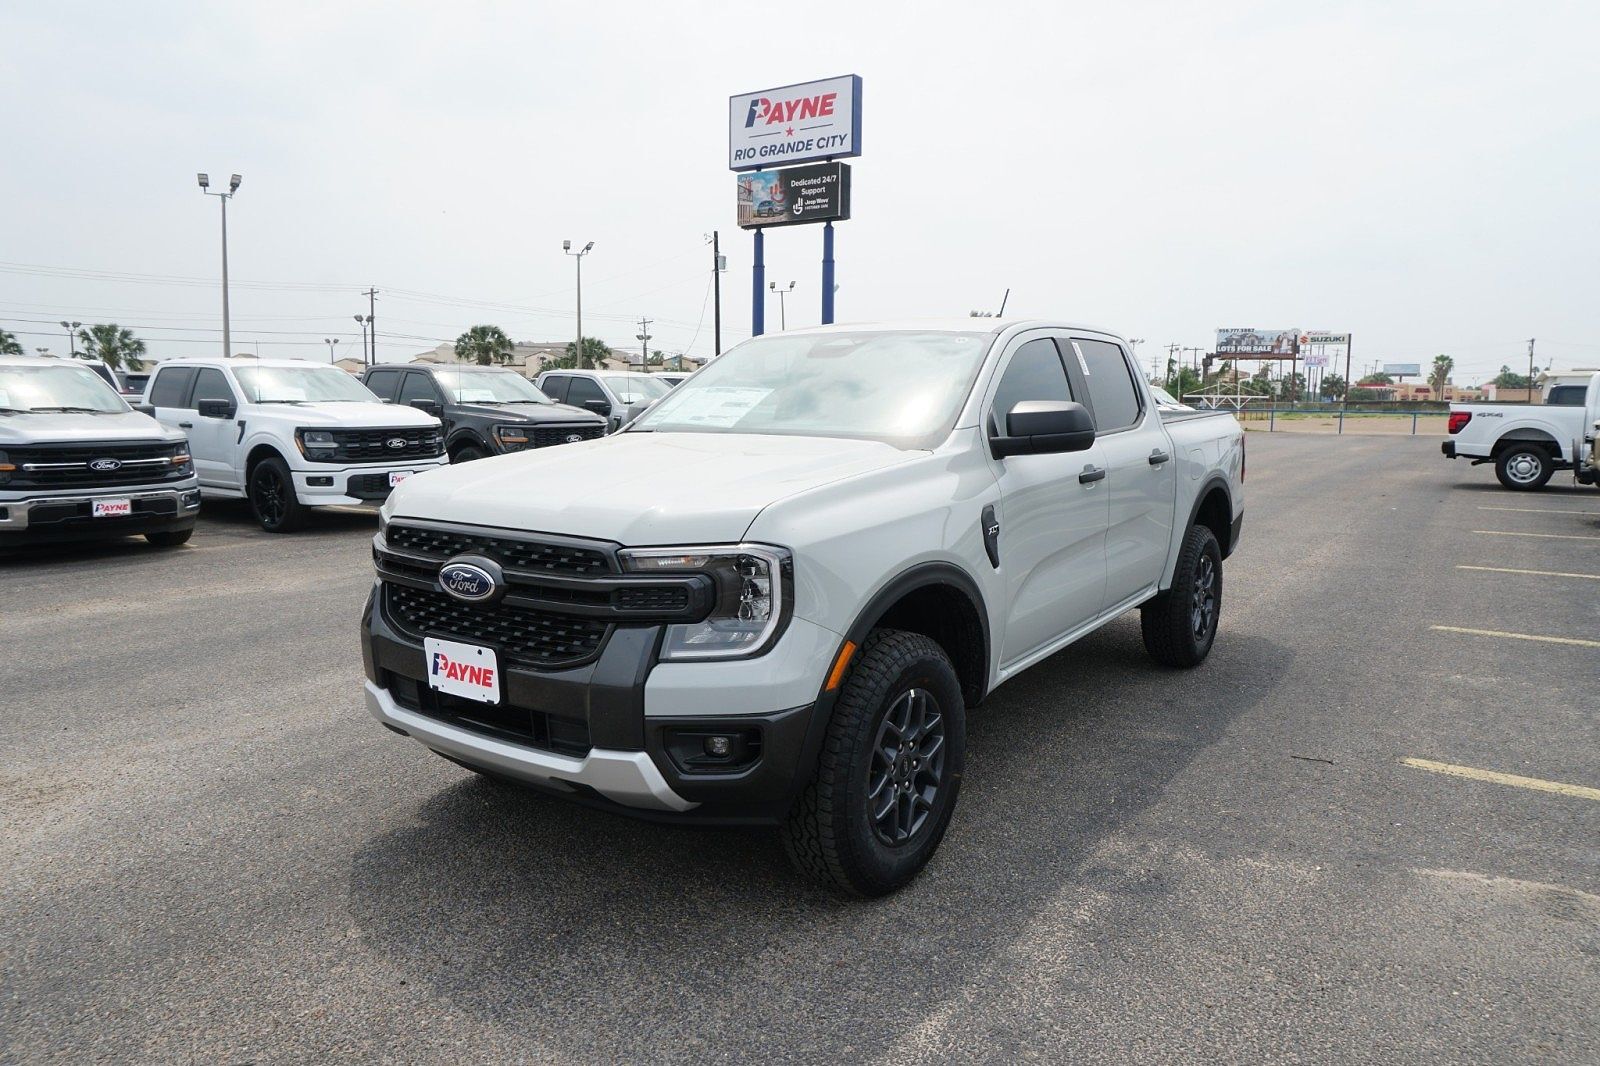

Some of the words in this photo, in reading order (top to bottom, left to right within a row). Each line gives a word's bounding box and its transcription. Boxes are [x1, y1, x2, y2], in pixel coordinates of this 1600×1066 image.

[745, 93, 837, 128] PAYNE
[734, 148, 756, 161] RIO
[759, 139, 814, 157] GRANDE
[816, 133, 848, 149] CITY
[791, 177, 821, 187] Dedicated
[822, 174, 837, 183] 24/7
[801, 186, 826, 195] Support
[96, 461, 116, 469] Ford
[95, 503, 129, 513] PAYNE
[449, 571, 479, 593] Ford
[432, 652, 494, 688] PAYNE
